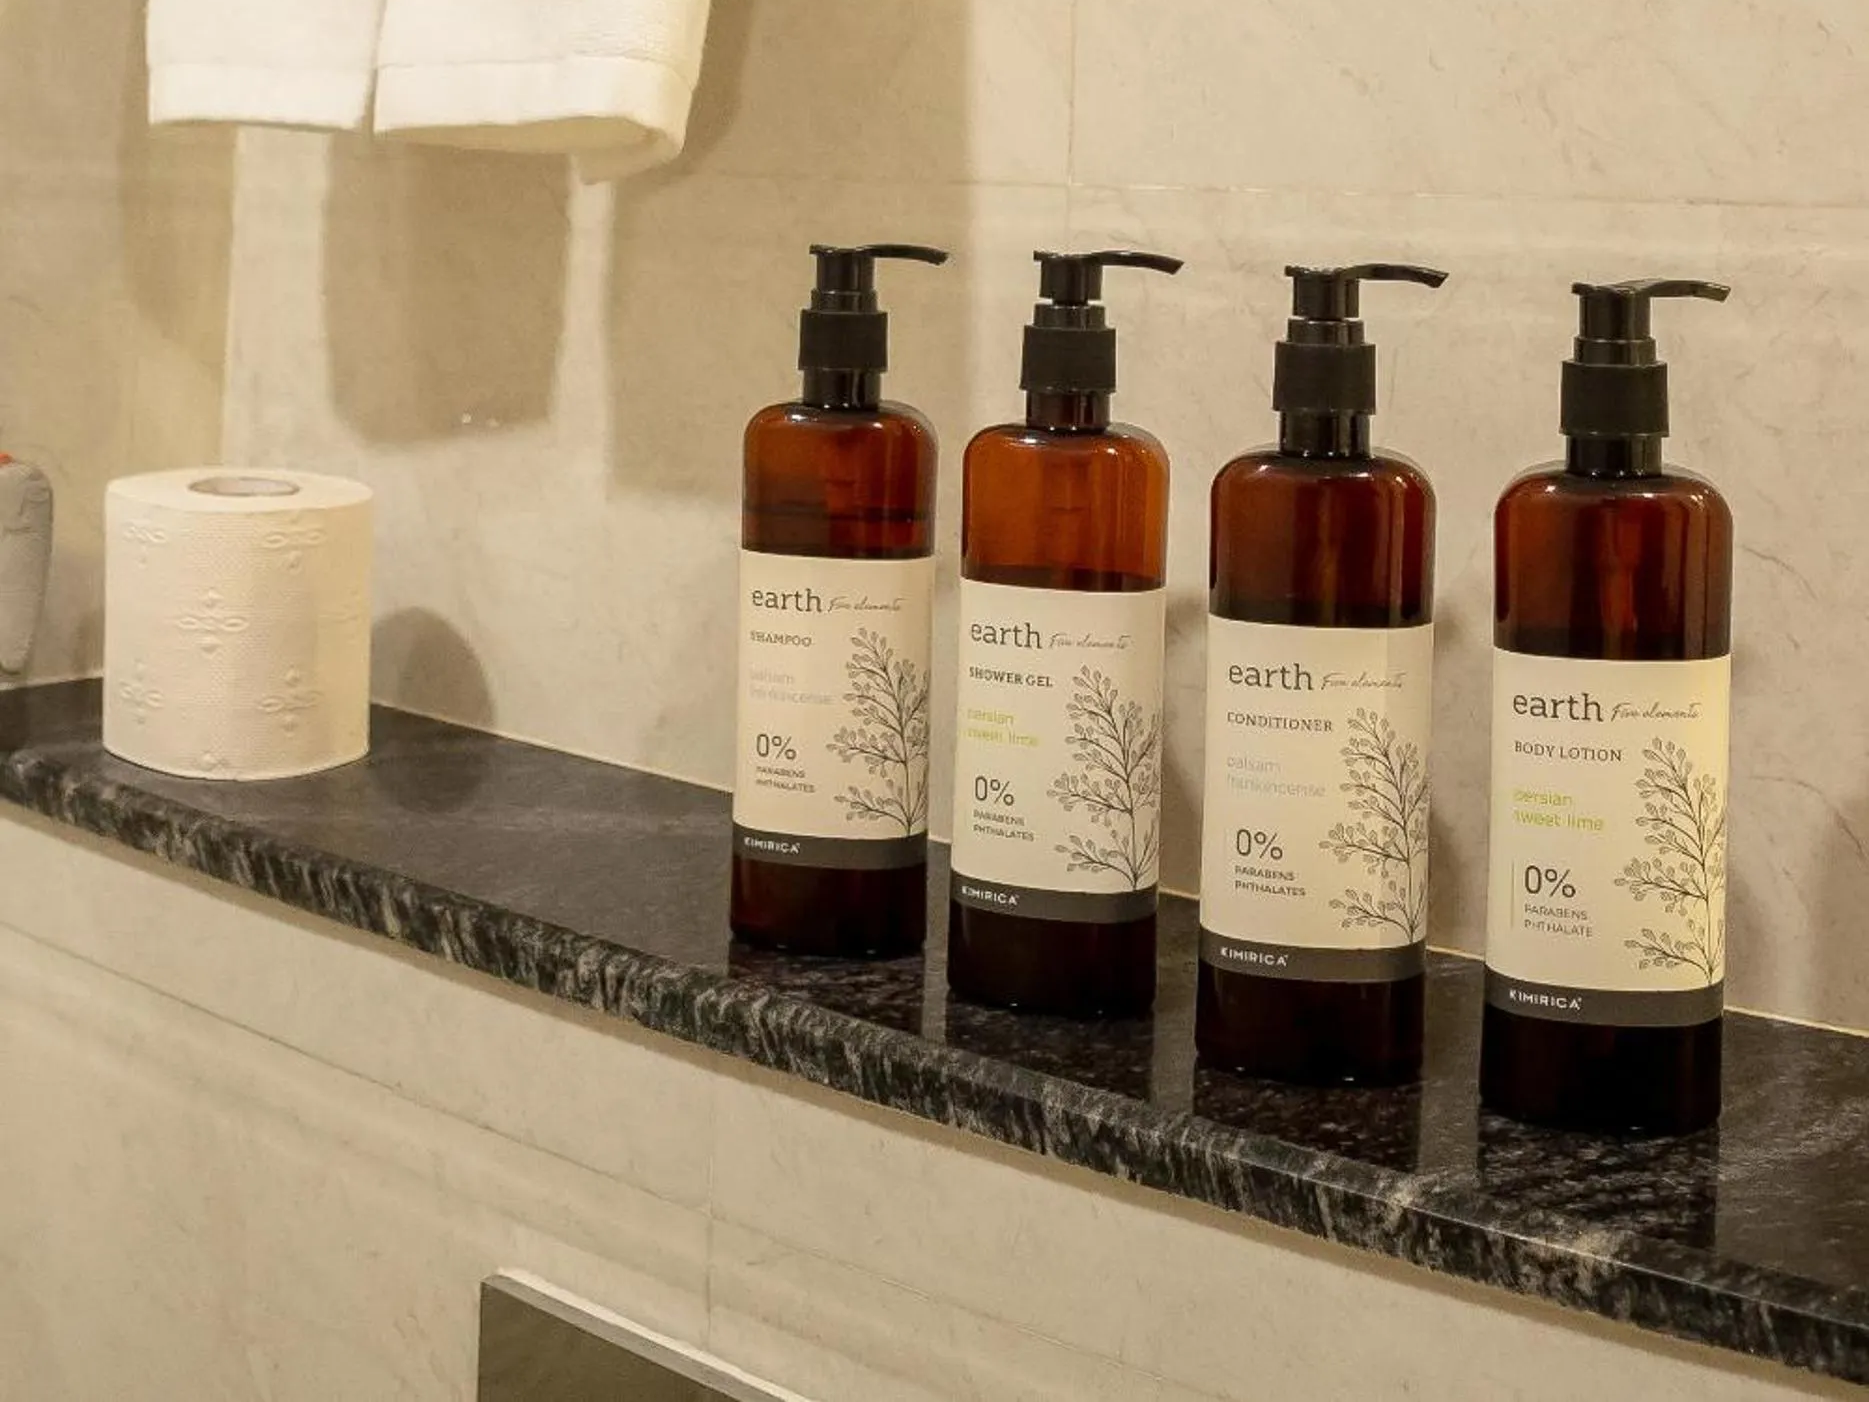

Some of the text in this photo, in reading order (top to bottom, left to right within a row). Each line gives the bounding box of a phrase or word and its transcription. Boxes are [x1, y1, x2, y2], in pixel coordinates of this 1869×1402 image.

[752, 588, 822, 612] earth
[750, 630, 813, 647] SHAMPOO
[971, 623, 1042, 649] earth
[969, 666, 1053, 688] SHOWER GEL
[1228, 662, 1314, 691] earth
[1513, 692, 1604, 722] earth
[1227, 711, 1333, 732] CONDITIONER
[756, 733, 797, 760] 0%
[1514, 740, 1623, 762] BODY LOTION
[975, 775, 1015, 807] 0%
[1236, 829, 1283, 860] 0%
[1234, 865, 1295, 882] PARABENS
[1524, 864, 1577, 898] 0%
[1234, 880, 1306, 897] PHTHALATES
[1524, 903, 1588, 920] PARABENS
[1524, 919, 1593, 938] PHTHALATE
